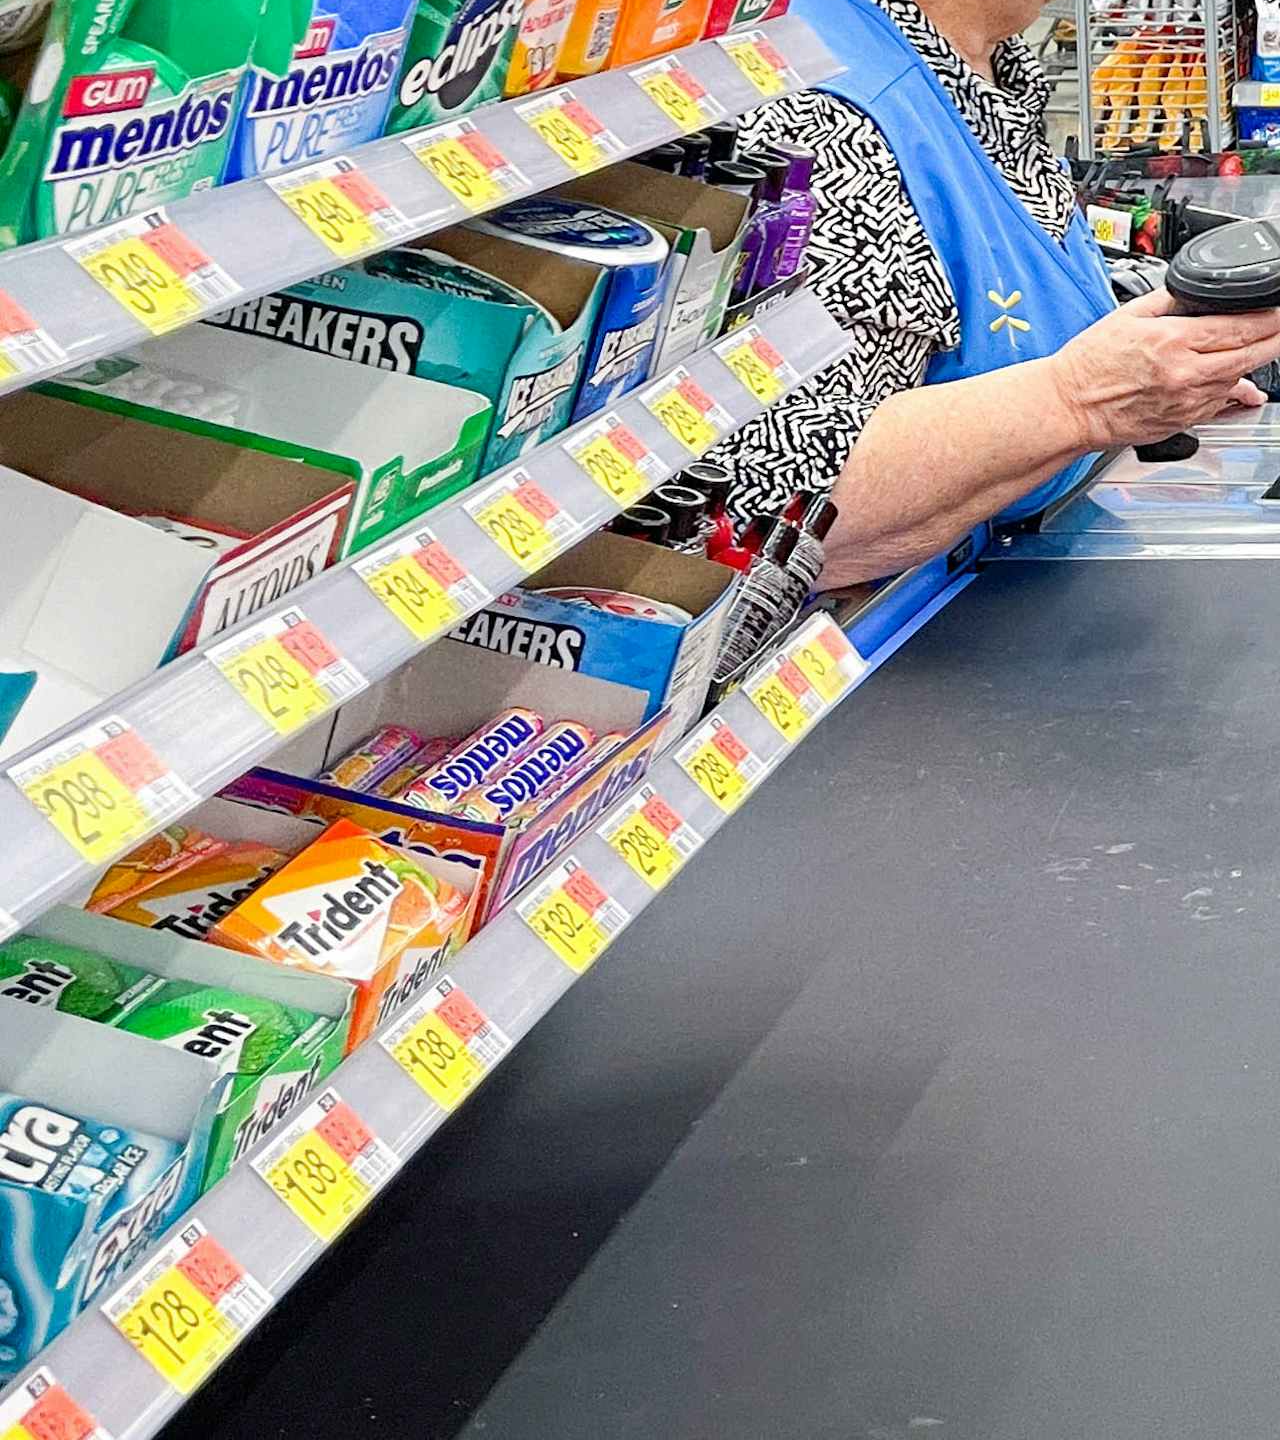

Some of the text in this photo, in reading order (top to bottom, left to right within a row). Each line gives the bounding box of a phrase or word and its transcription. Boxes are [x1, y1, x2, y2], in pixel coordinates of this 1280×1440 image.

[251, 44, 400, 112] mentos
[50, 88, 233, 176] mentos
[428, 715, 536, 801] mentos
[484, 728, 586, 816] mentos
[277, 859, 402, 958] Trident
[234, 1054, 322, 1161] Trident
